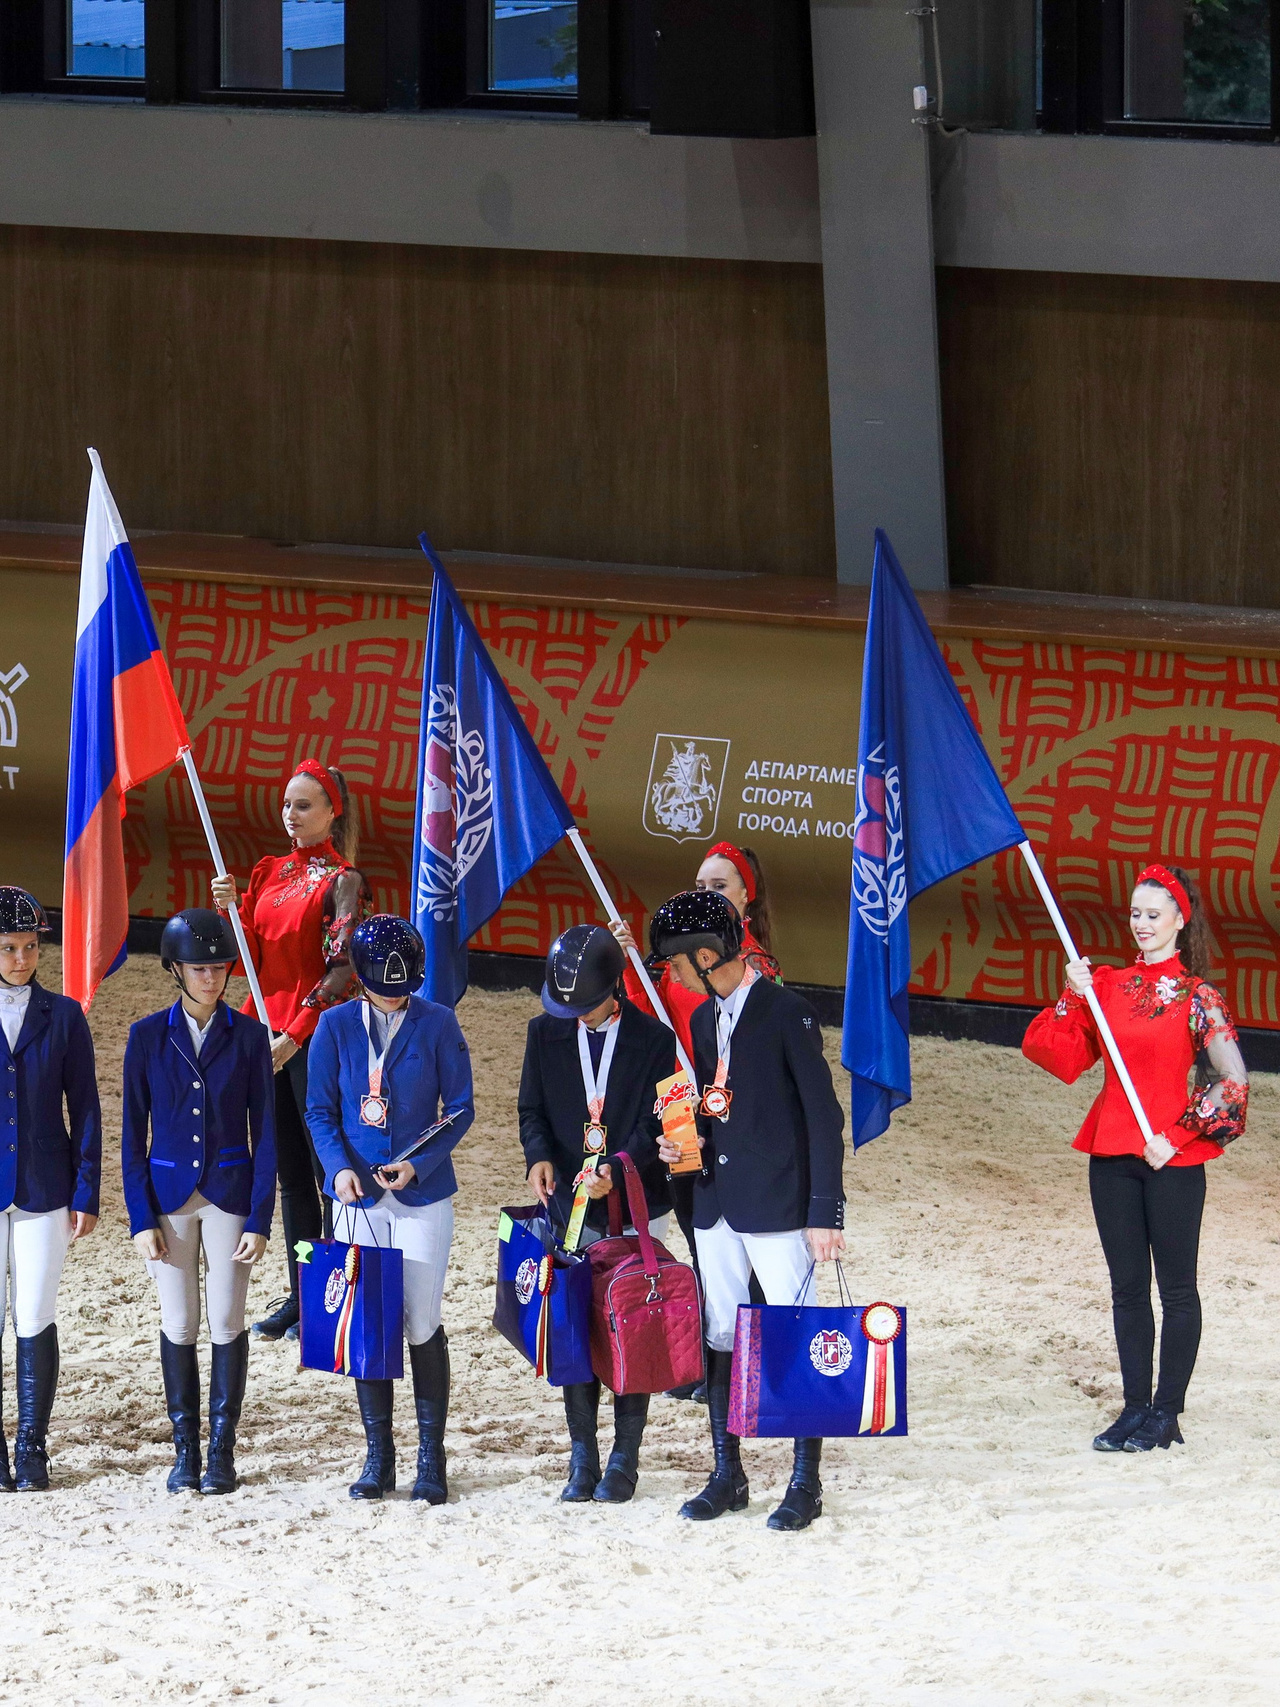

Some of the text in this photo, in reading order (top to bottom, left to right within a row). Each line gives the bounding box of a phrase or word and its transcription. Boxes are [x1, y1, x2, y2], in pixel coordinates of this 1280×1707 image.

[745, 759, 856, 786] ДЕПАРТАМЕ
[741, 786, 814, 809] СПОРТА
[737, 812, 810, 838] ГОРОДА
